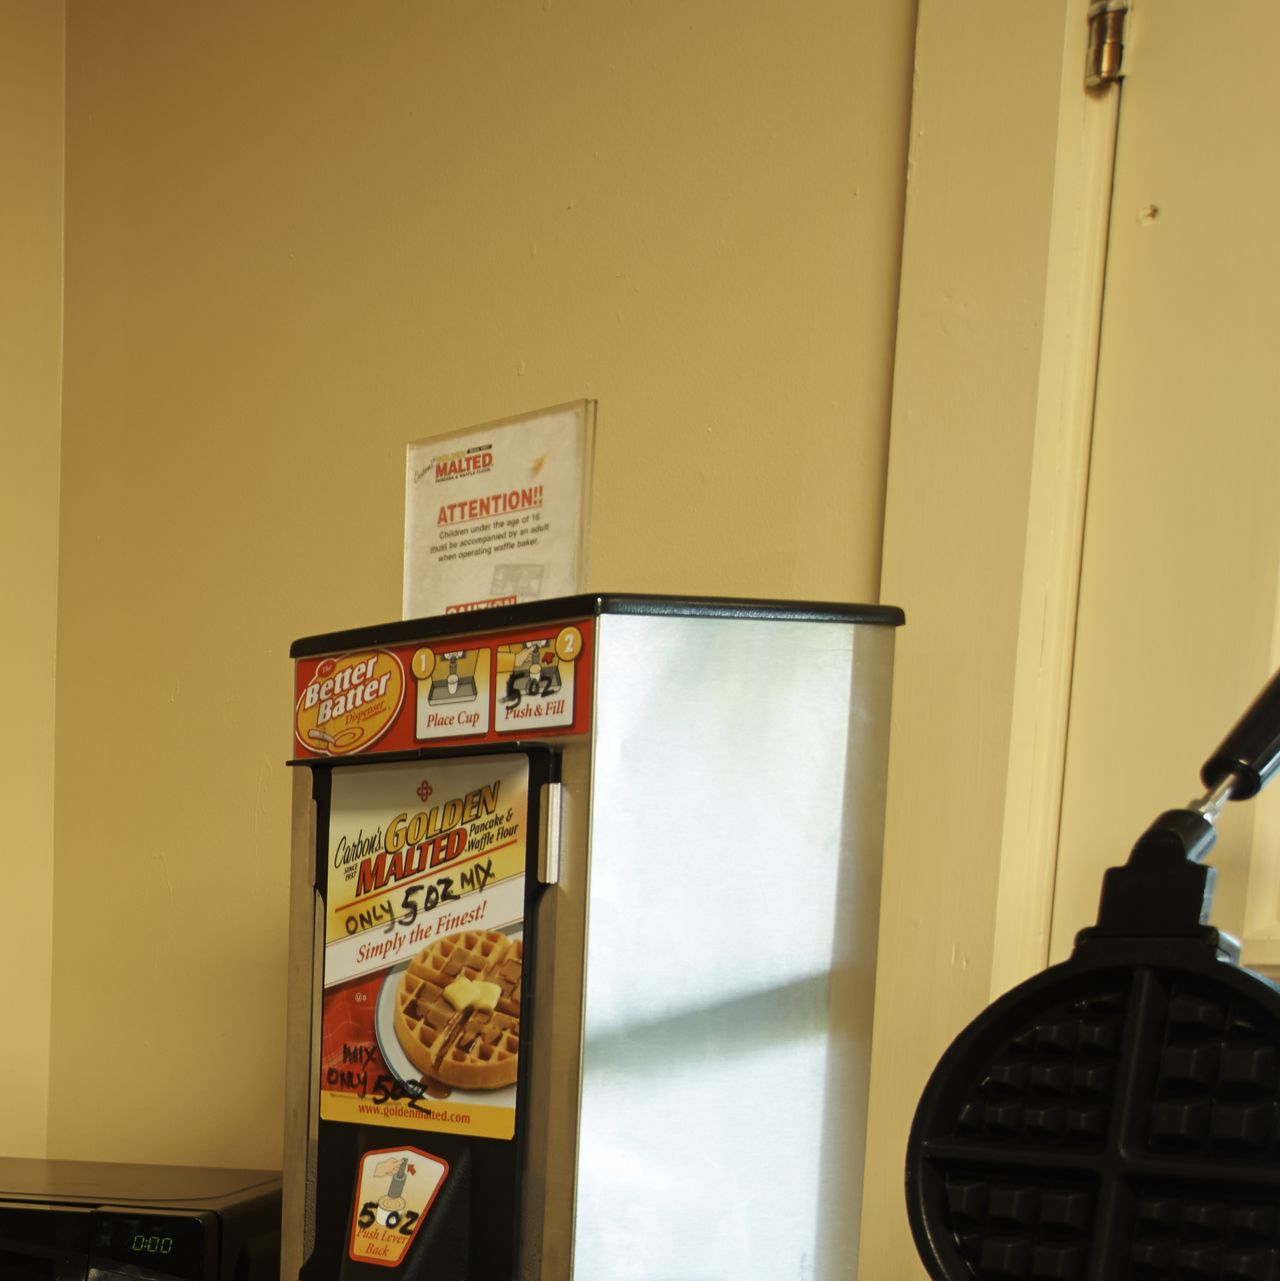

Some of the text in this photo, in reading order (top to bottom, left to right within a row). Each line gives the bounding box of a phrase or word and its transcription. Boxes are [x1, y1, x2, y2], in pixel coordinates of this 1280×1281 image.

[435, 453, 493, 479] MALTED
[437, 485, 543, 525] ATTENTION!!
[430, 544, 447, 553] must
[449, 541, 458, 549] be
[459, 532, 506, 547] accompanied
[508, 530, 517, 538] by
[530, 523, 549, 533] adult
[439, 528, 469, 539] Children
[470, 523, 490, 533] under
[493, 520, 505, 528] the
[506, 518, 520, 528] age
[521, 515, 529, 523] of
[438, 552, 456, 562] when
[458, 546, 492, 560] operating
[493, 541, 515, 552] waffle
[565, 634, 574, 652] 2
[322, 664, 333, 674] The
[421, 654, 426, 672] 1
[304, 655, 378, 710] Better
[498, 671, 525, 710] 5
[316, 671, 391, 727] Batter
[504, 699, 565, 720] Push & Fill
[346, 701, 385, 726] Dispenser
[426, 710, 480, 728] Place Cup
[334, 780, 501, 869] Carbon's GOLDEN
[469, 807, 513, 837] Pancake &
[467, 824, 519, 853] Waffle Flour
[355, 827, 468, 897] MALTED
[346, 900, 396, 935] ONLY
[460, 857, 496, 892] MIX
[356, 900, 487, 964] Simply the Finest!
[358, 1103, 471, 1124] www.goldenmalted.com
[358, 1201, 379, 1229] 5
[133, 1235, 173, 1253] 0:00
[356, 1228, 408, 1245] Push Lever
[365, 1242, 389, 1257] Back
